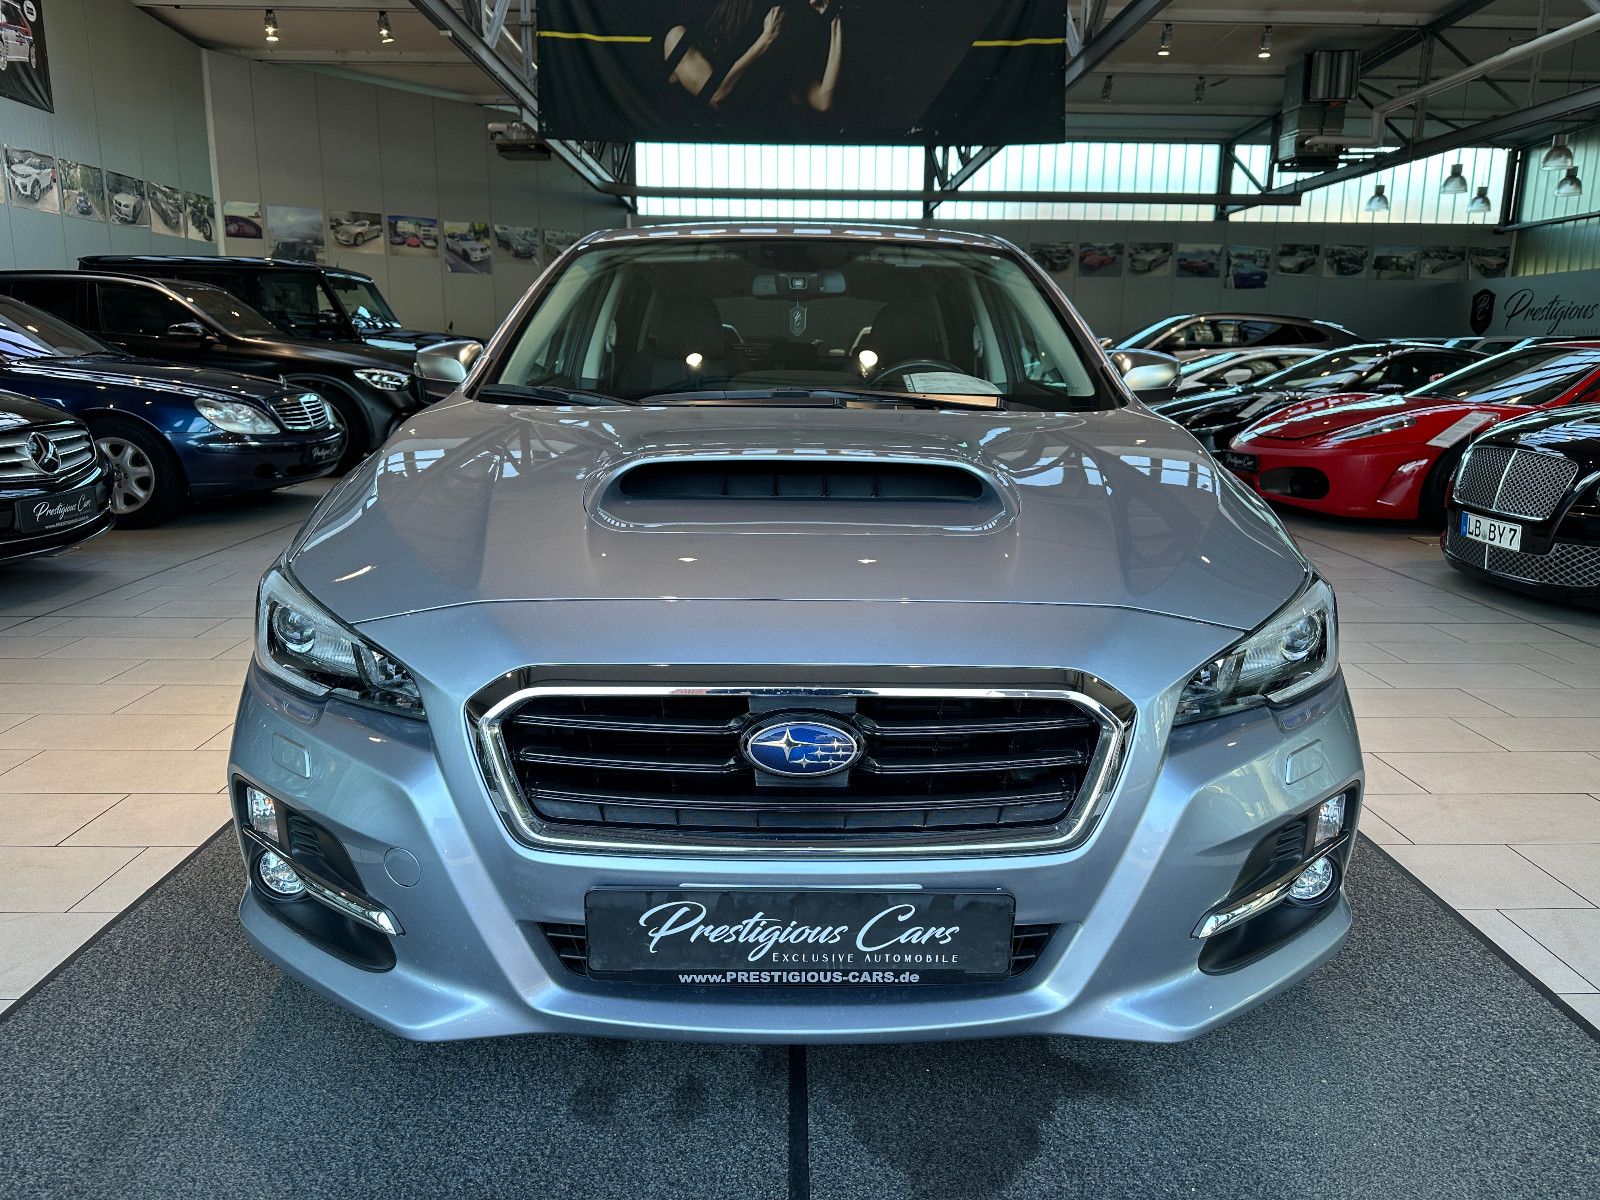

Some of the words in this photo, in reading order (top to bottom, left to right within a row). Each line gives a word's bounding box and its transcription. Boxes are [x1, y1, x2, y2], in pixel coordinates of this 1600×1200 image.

[1504, 288, 1599, 335] Prestigious
[1467, 517, 1482, 537] LB
[639, 901, 849, 962] Prestigious
[855, 903, 960, 952] Cars
[772, 952, 854, 963] EXCLUSIVE
[864, 954, 959, 963] AUTOMOBILE
[678, 971, 920, 983] www.PRESTIGIOUS-CARS.de
